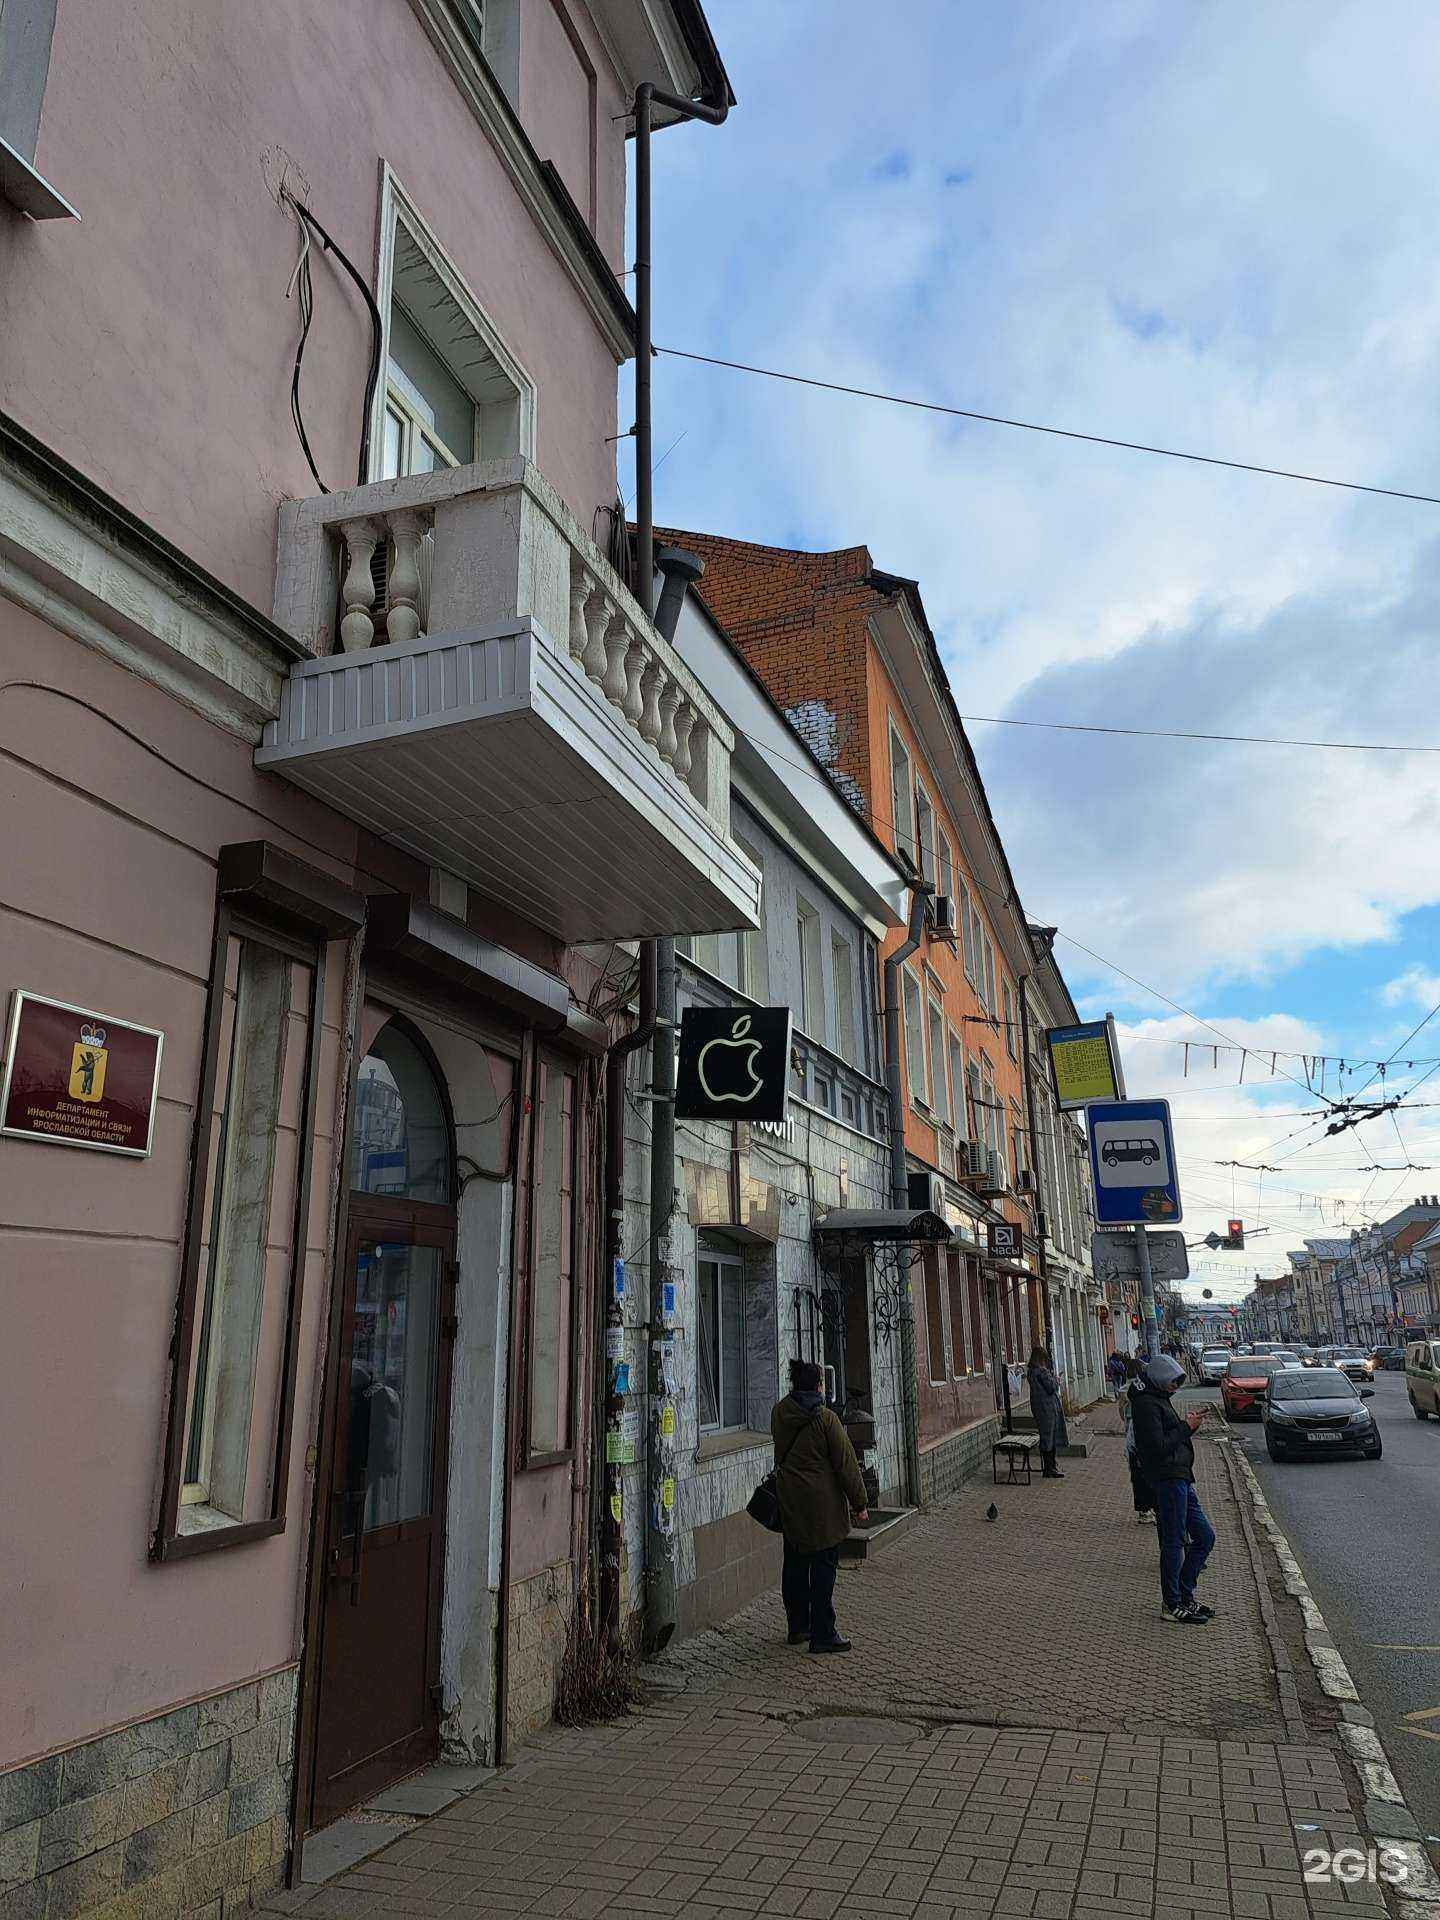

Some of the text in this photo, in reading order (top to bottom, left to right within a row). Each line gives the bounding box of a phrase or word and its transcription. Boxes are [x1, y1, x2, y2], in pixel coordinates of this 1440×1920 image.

[27, 1107, 132, 1134] ИНФОРМАТИЗАЦИИ И СВЯЗИ
[56, 1101, 110, 1119] ДЕПАРТАМЕНТ
[32, 1119, 125, 1143] ЯРОСЛАВСКОЙ ОБЛАСТИ
